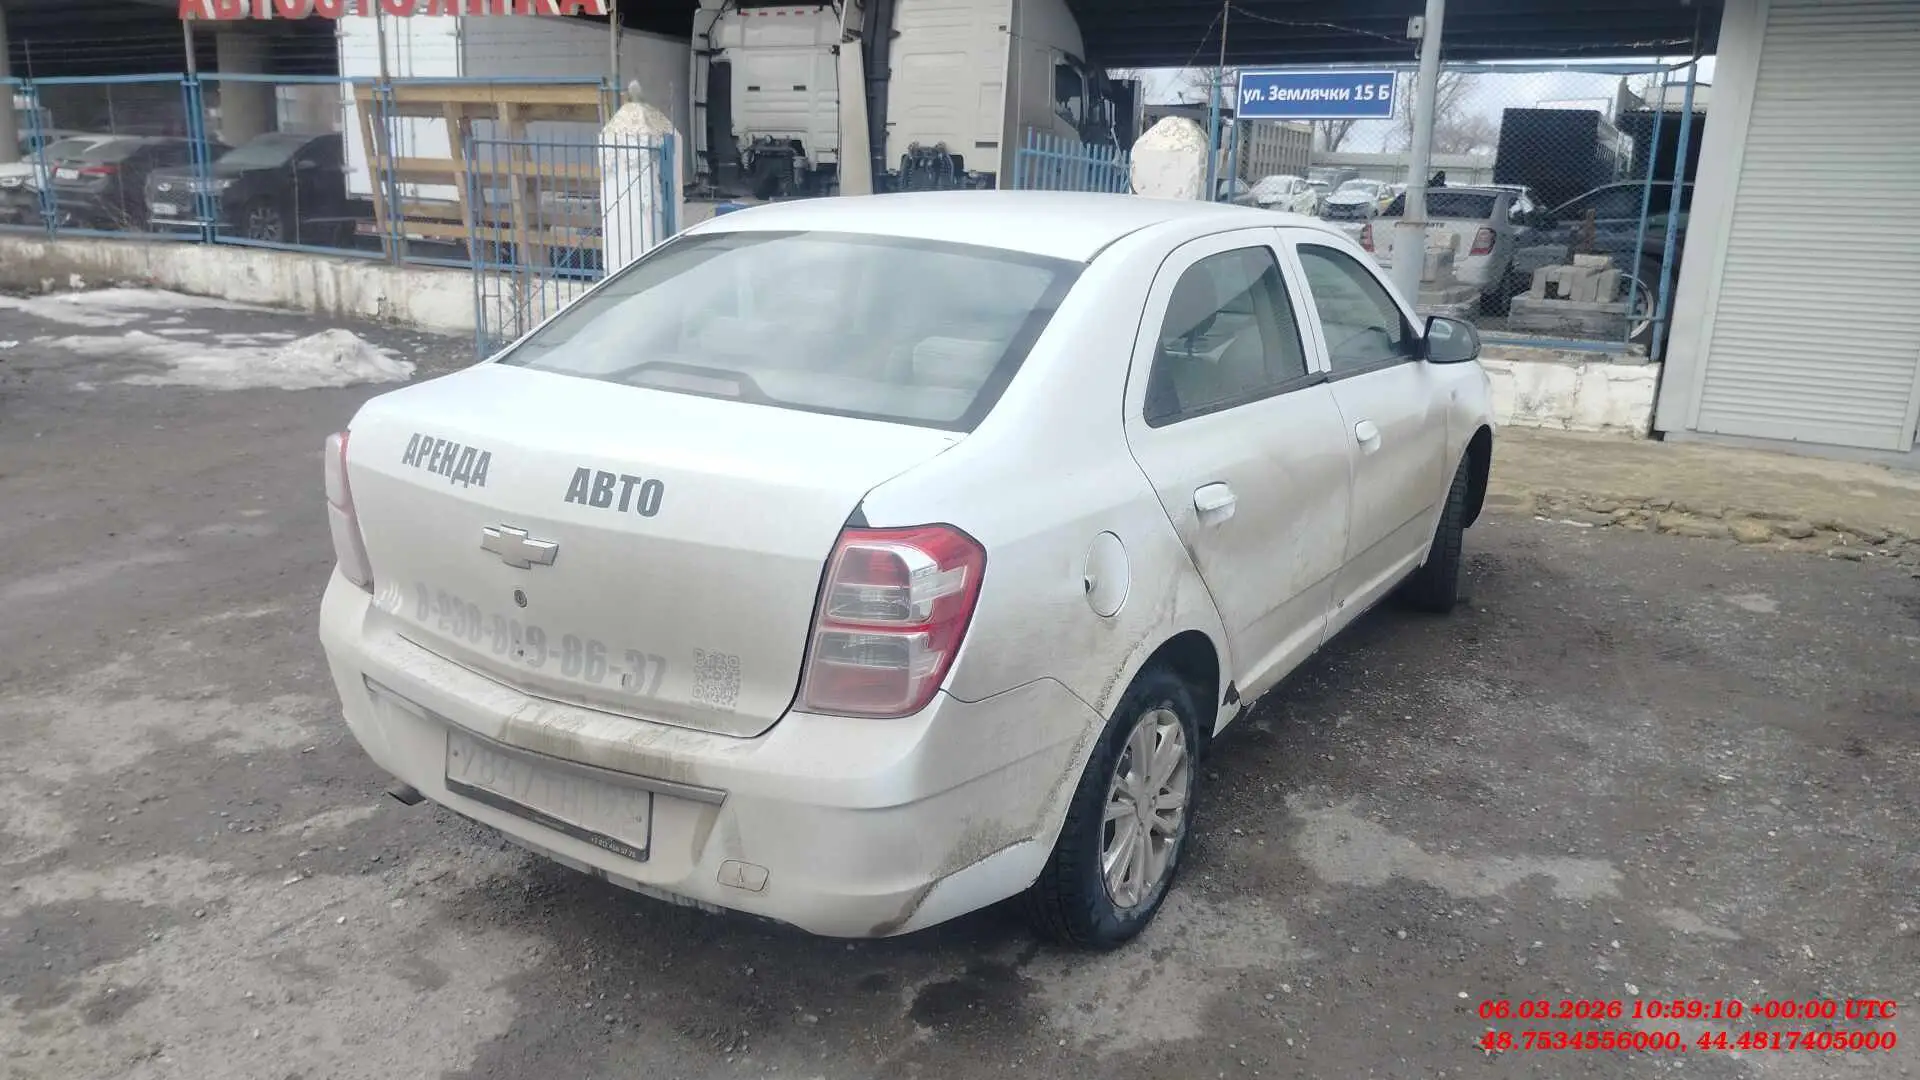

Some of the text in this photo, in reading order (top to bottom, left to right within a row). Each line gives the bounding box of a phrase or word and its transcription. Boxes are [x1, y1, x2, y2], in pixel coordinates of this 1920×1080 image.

[1243, 84, 1390, 104] ул. Землячки 15 Б
[401, 432, 665, 518] АРЕНДА АВТО
